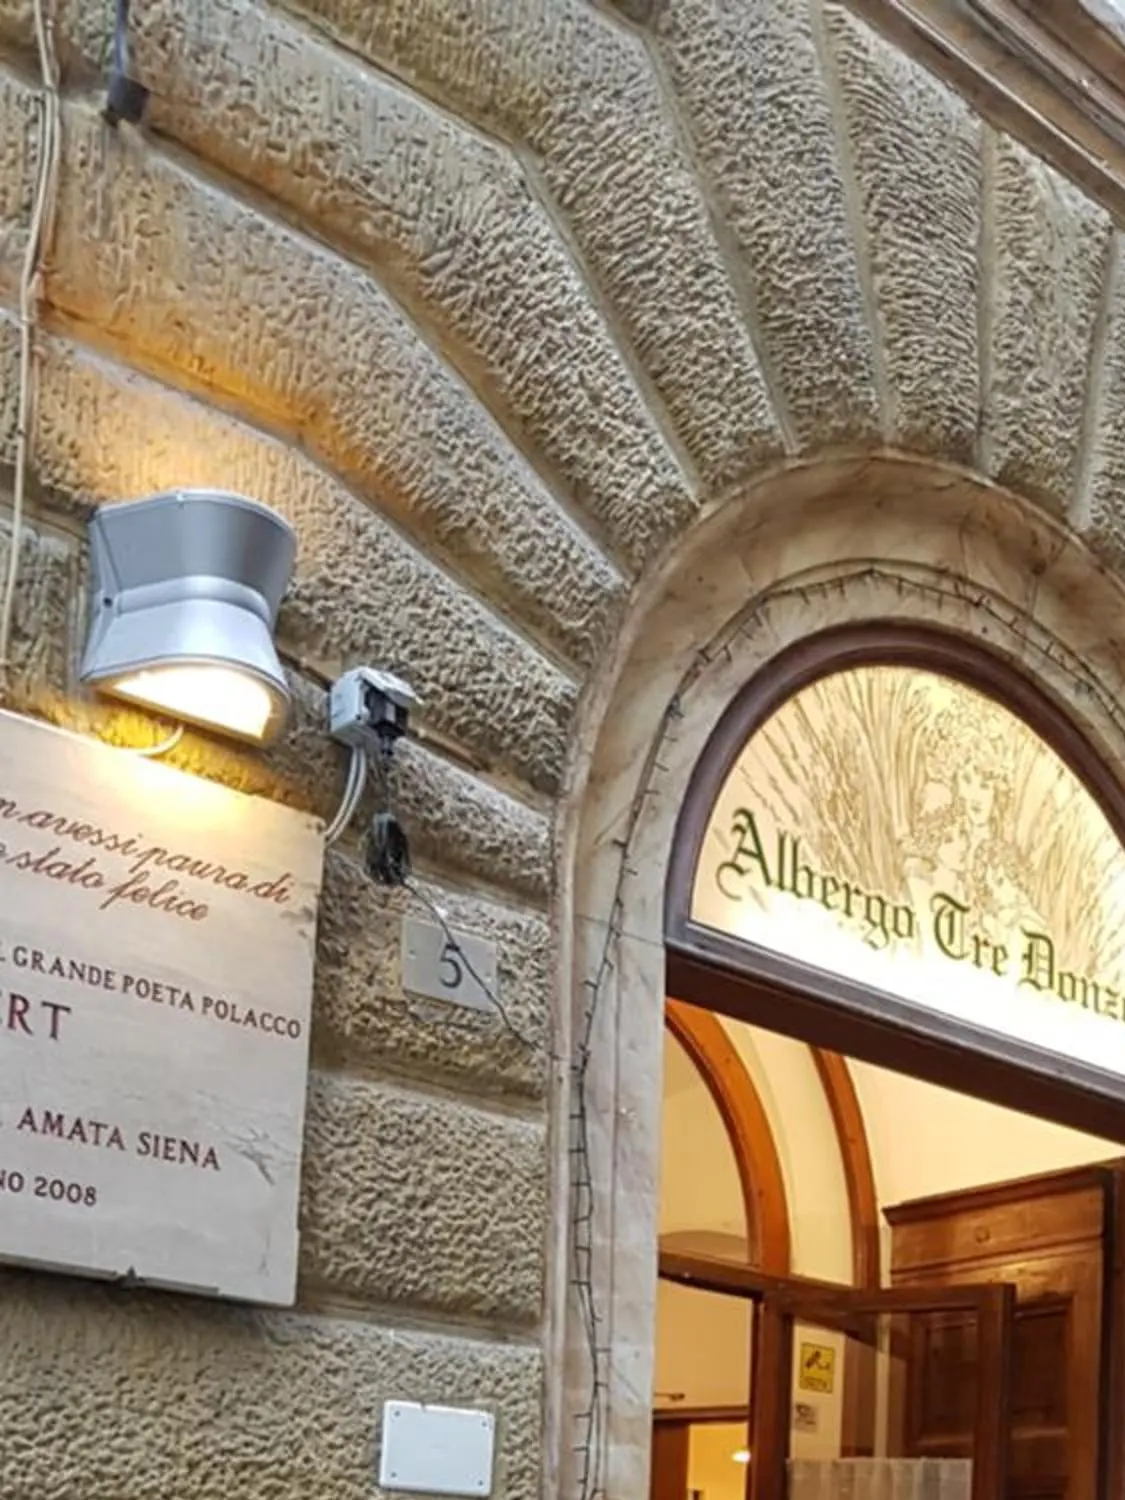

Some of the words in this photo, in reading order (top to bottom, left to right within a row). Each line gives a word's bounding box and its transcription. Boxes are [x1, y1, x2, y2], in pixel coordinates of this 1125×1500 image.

[715, 807, 915, 950] Albergo
[932, 891, 1009, 976] Tre
[13, 945, 117, 991] GRANDE
[121, 974, 196, 1012] POETA
[201, 996, 301, 1039] POLACCO
[439, 943, 462, 989] 5
[0, 991, 71, 1041] RT
[16, 1106, 126, 1151] AMATA
[136, 1131, 221, 1171] SIENA
[34, 1175, 97, 1207] 2008
